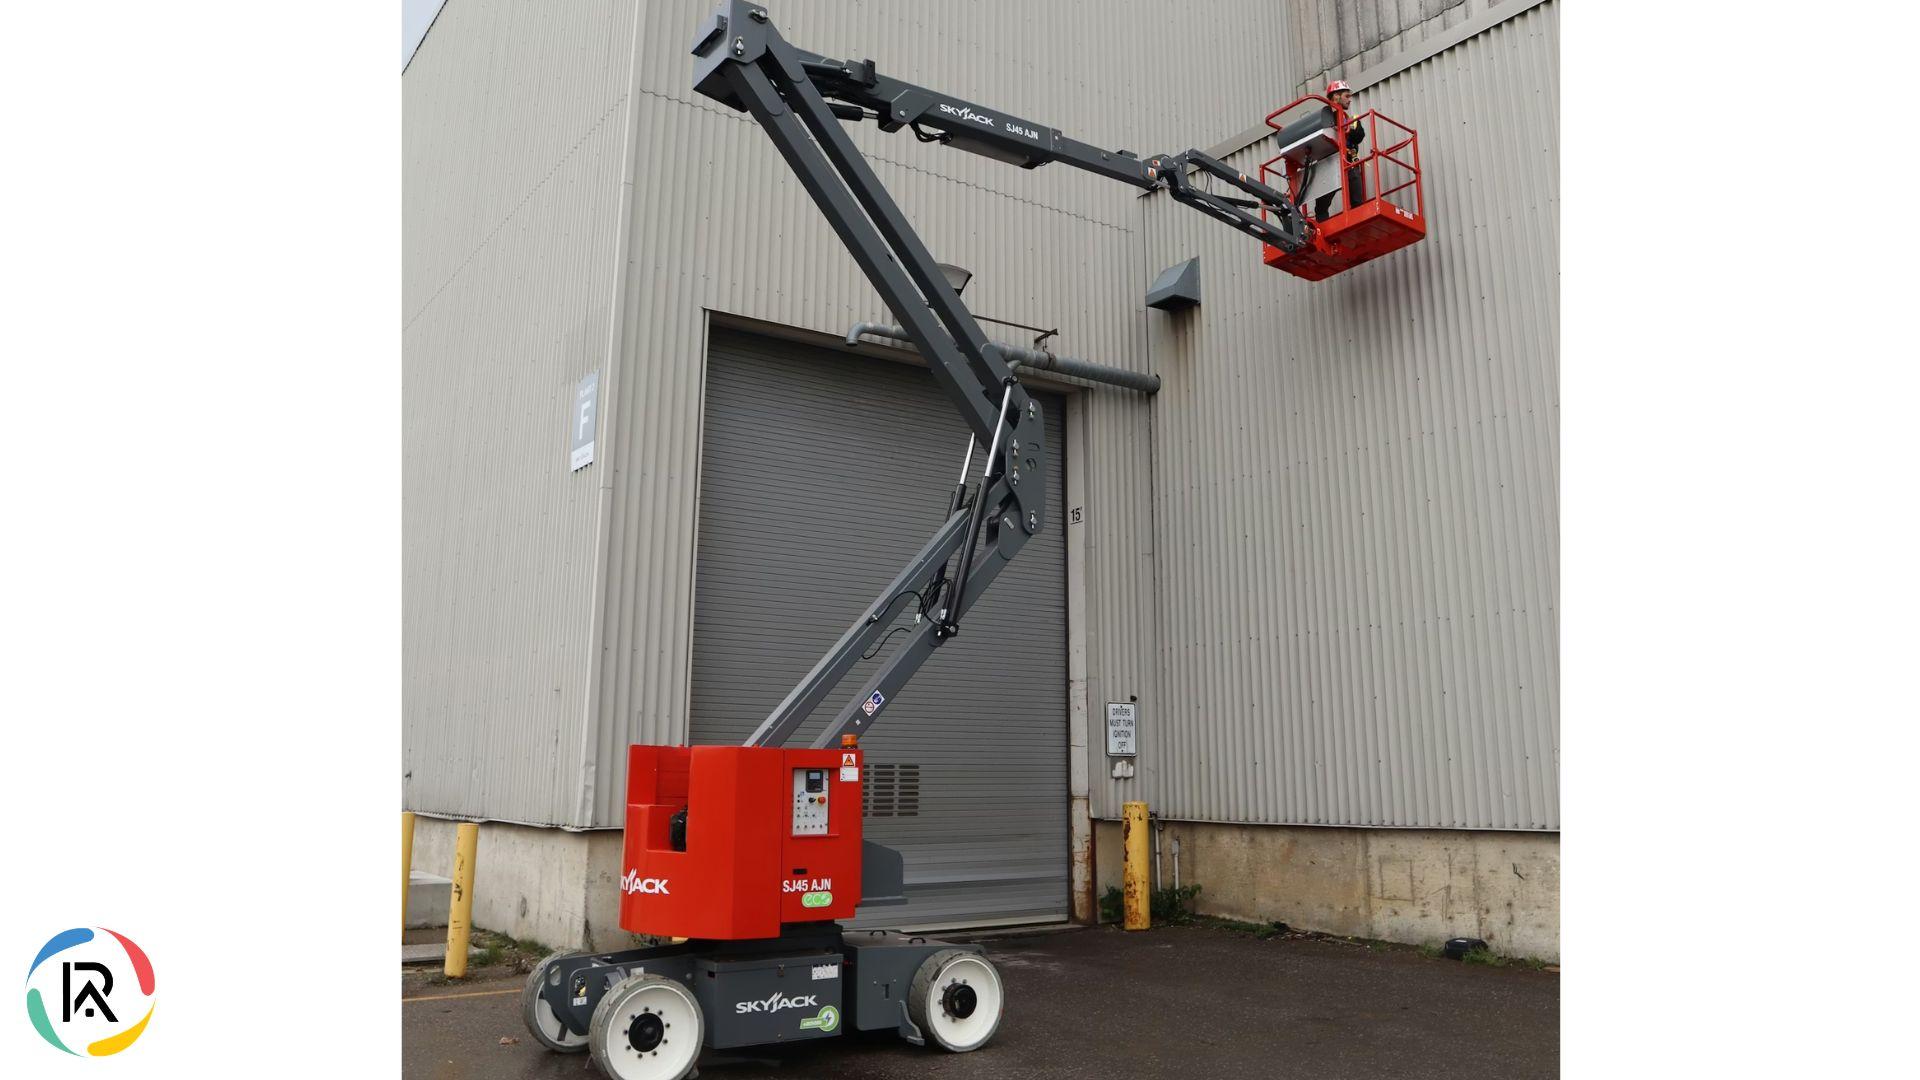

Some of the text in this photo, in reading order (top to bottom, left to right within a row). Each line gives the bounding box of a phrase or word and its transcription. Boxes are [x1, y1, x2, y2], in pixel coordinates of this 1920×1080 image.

[940, 103, 995, 127] SKYJACK
[1006, 123, 1039, 140] SJ45 AJN
[579, 400, 591, 441] F
[1112, 707, 1131, 717] DRIVERS
[1109, 719, 1134, 727] MUST TURN
[1112, 729, 1132, 738] IGNITION
[620, 868, 670, 895] KYJACK
[782, 878, 832, 893] SJ45 AJN
[736, 991, 818, 1014] SKYJACK
